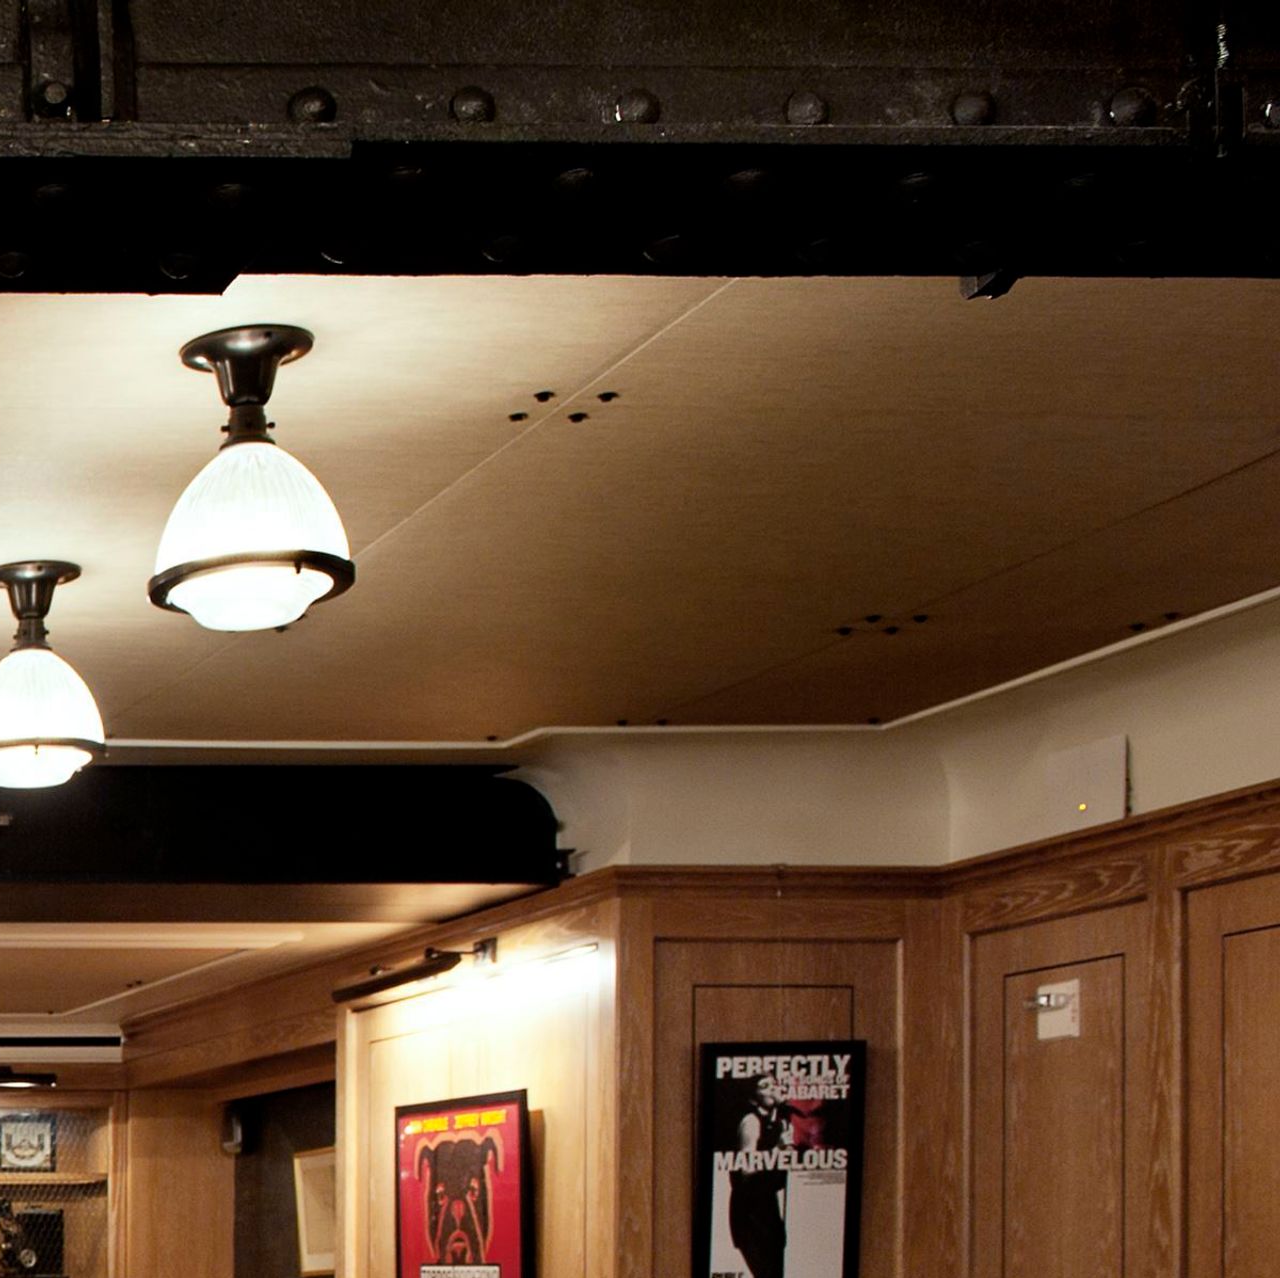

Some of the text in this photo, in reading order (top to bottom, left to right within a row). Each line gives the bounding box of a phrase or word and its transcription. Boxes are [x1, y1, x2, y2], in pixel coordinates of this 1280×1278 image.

[716, 1055, 850, 1079] PERFECTLY
[777, 1085, 850, 1100] CABARET
[714, 1149, 848, 1172] MARVELOUS
